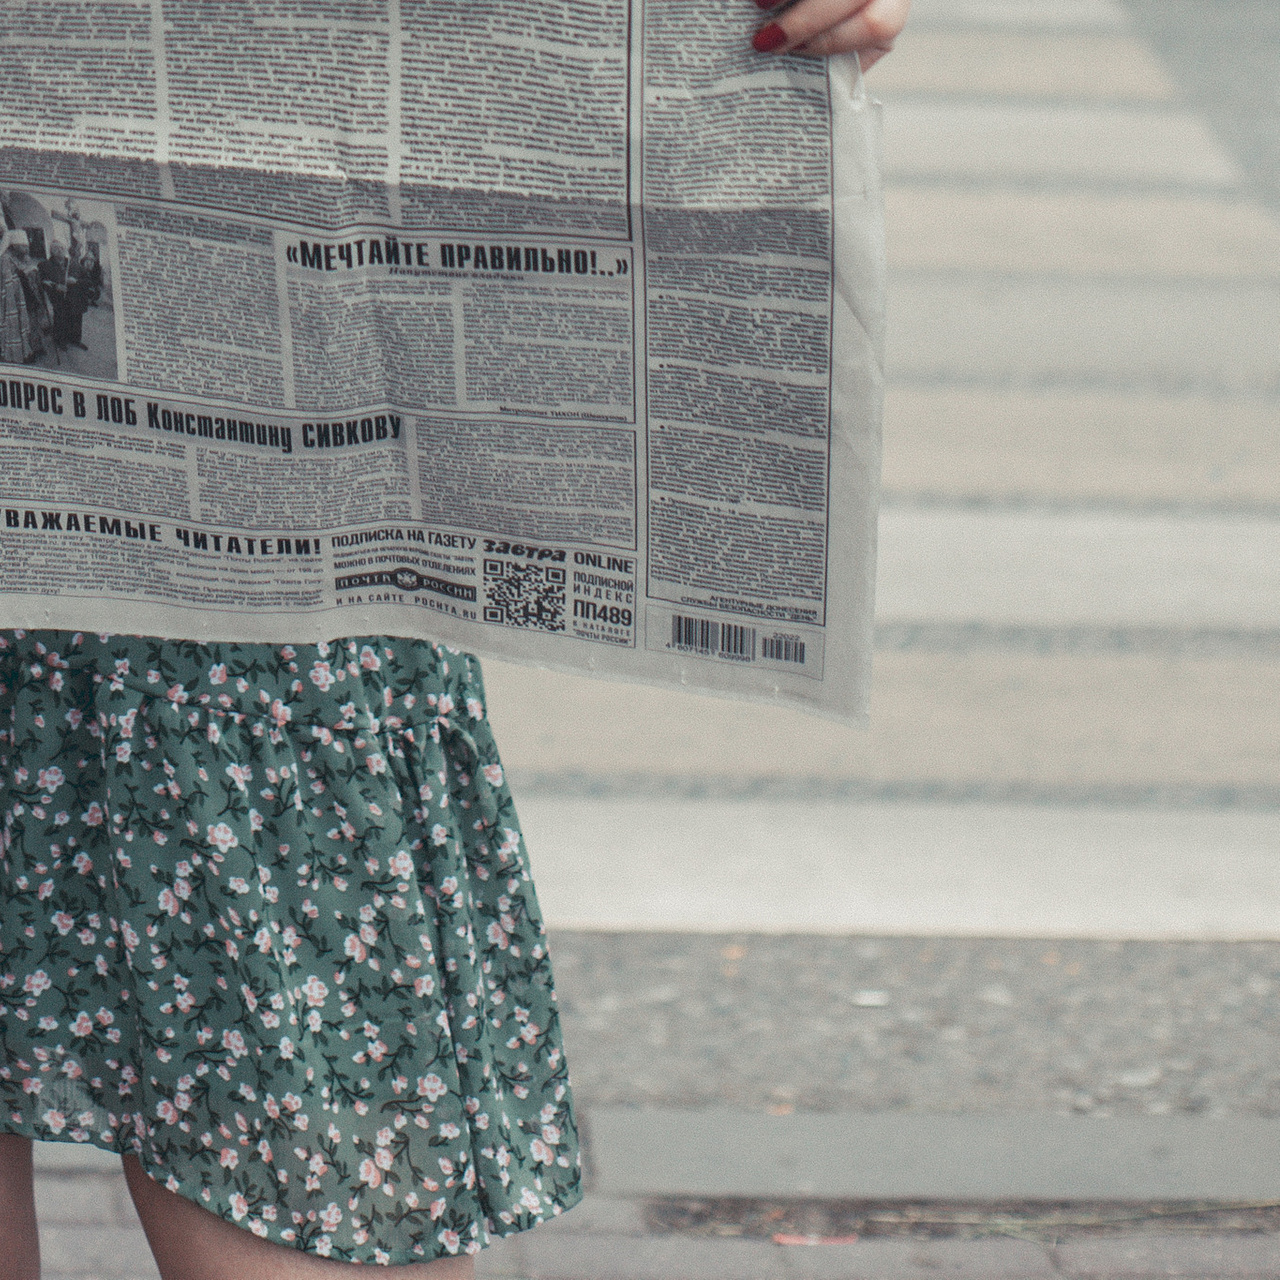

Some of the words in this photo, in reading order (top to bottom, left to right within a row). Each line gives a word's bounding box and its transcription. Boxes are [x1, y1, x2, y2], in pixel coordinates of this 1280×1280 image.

[287, 235, 429, 270] «МЕЧТАЙТЕ
[72, 390, 86, 418] В
[96, 394, 137, 426] ЛОБ
[147, 402, 291, 453] Константину
[302, 413, 402, 448] СИВКОВУ
[175, 528, 321, 556] ЧИТАТЕЛИ!
[331, 528, 404, 548] ПОДПИСКА
[407, 529, 425, 543] НА
[428, 531, 477, 550] ГАЗЕТУ
[334, 556, 365, 570] МОЖНО
[368, 556, 374, 565] В
[375, 555, 420, 566] ПОЧТОВЫХ
[422, 558, 477, 577] ОТДЕЛЕНИЯХ
[574, 552, 634, 575] ONLINE
[423, 578, 472, 598] РОССИИ
[574, 571, 634, 593] ПОДПИСНОЙ
[336, 598, 343, 606] И
[349, 595, 363, 603] НА
[368, 592, 405, 603] САЙТЕ
[574, 584, 633, 605] ИНДЕКС
[574, 598, 632, 627] ПП489
[765, 603, 818, 616] ДОНЕСЕНИЯ
